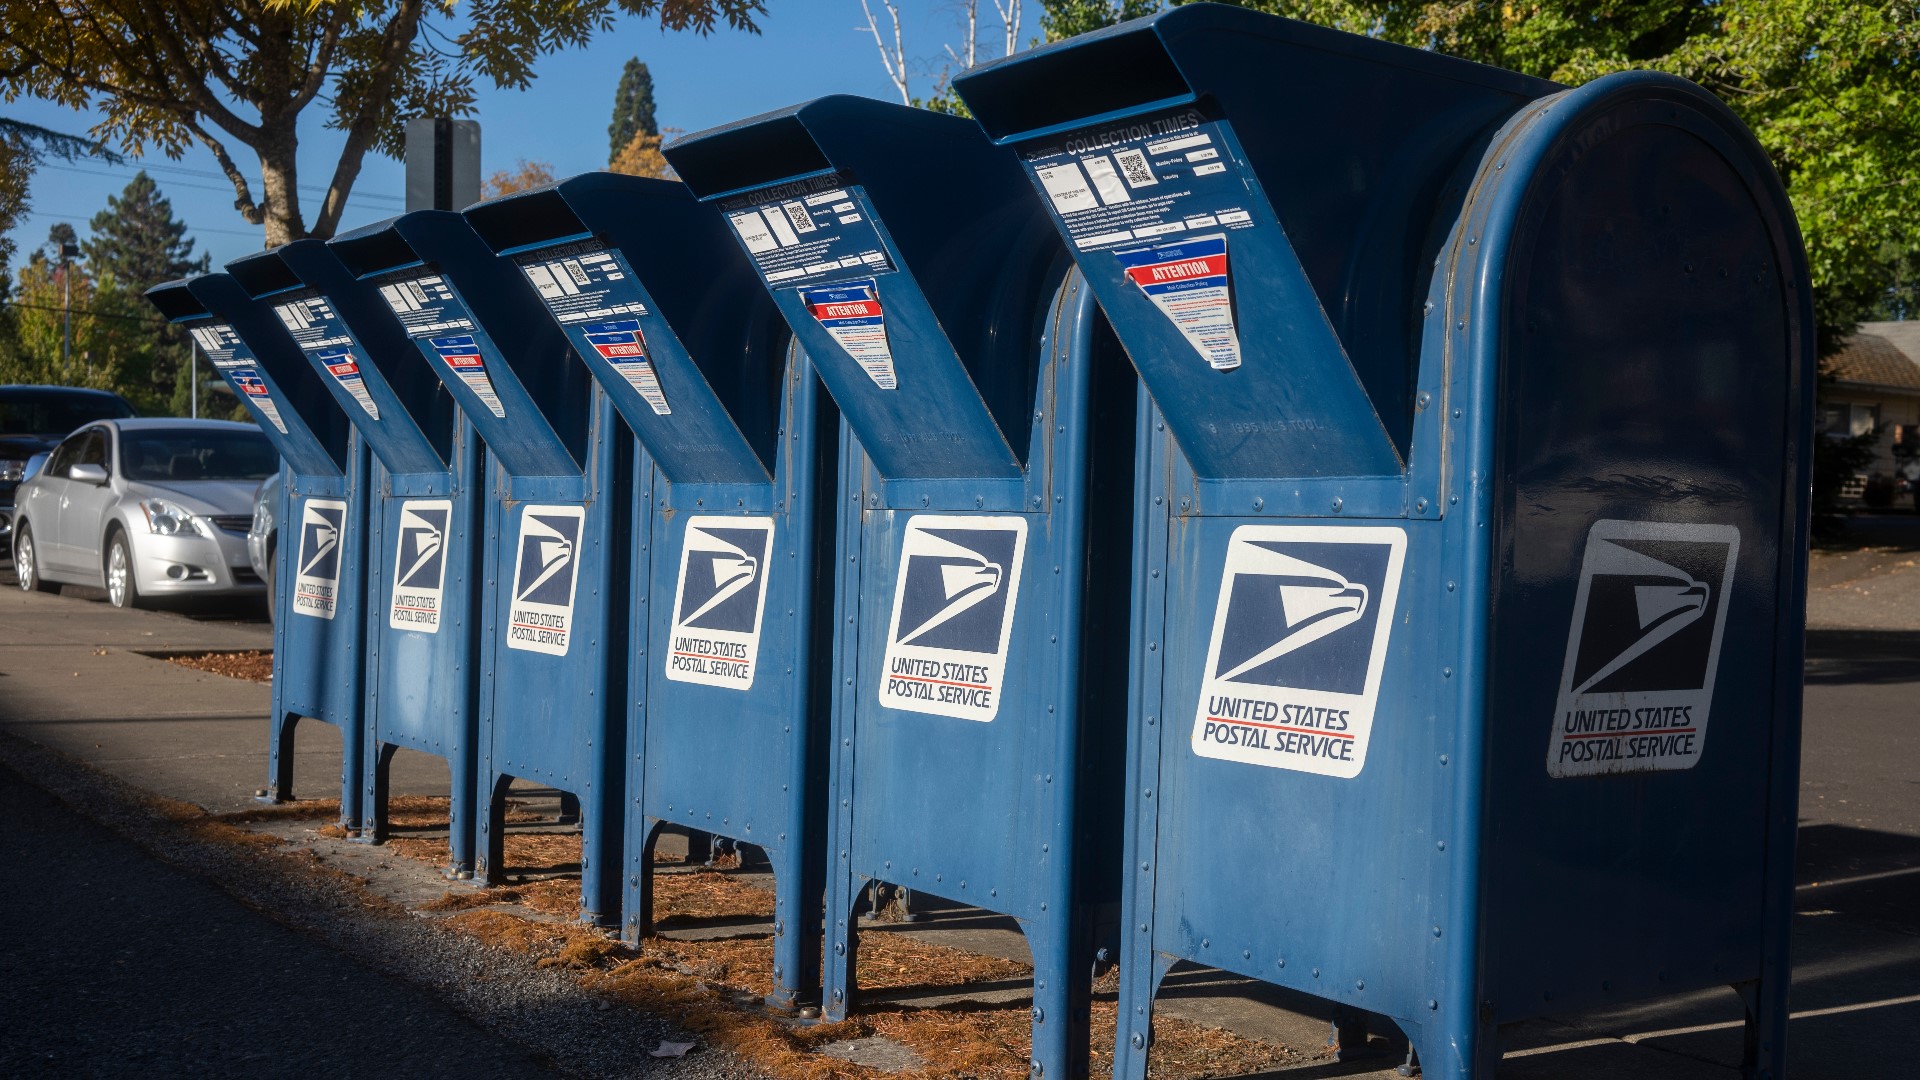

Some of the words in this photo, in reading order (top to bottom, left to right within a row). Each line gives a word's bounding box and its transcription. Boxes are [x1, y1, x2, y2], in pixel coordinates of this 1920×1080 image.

[1065, 122, 1153, 156] COLLECTION
[1153, 112, 1200, 136] TIMES
[748, 180, 807, 206] COLLECTION
[808, 174, 839, 192] TIMES
[1152, 260, 1210, 280] ATTENTION
[826, 302, 868, 317] ATTENTION
[609, 345, 640, 355] ATTENTION
[1288, 419, 1324, 430] TOOL
[298, 583, 316, 594] UNITED
[316, 585, 332, 597] STATES
[296, 596, 313, 608] POSTAL
[314, 599, 333, 611] SERVICE
[395, 594, 416, 606] UNITED
[416, 596, 435, 608] STATES
[394, 609, 413, 621] POSTAL
[415, 612, 437, 624] SERVICE
[514, 610, 539, 624] UNITED
[540, 614, 564, 628] STATES
[512, 627, 536, 642] POSTAL
[538, 631, 565, 646] SERVICE
[675, 637, 711, 654] UNITED
[713, 641, 747, 658] STATES
[672, 656, 707, 673] POSTAL
[709, 661, 749, 679] SERVICE
[892, 657, 940, 677] UNITED
[942, 663, 988, 683] STATES
[888, 679, 934, 700] POSTAL
[1208, 696, 1279, 722] UNITED
[1280, 704, 1349, 731] STATES
[1565, 708, 1631, 733] UNITED
[1632, 706, 1692, 729] STATES
[1203, 722, 1270, 750] POSTAL
[1559, 739, 1623, 763] POSTAL
